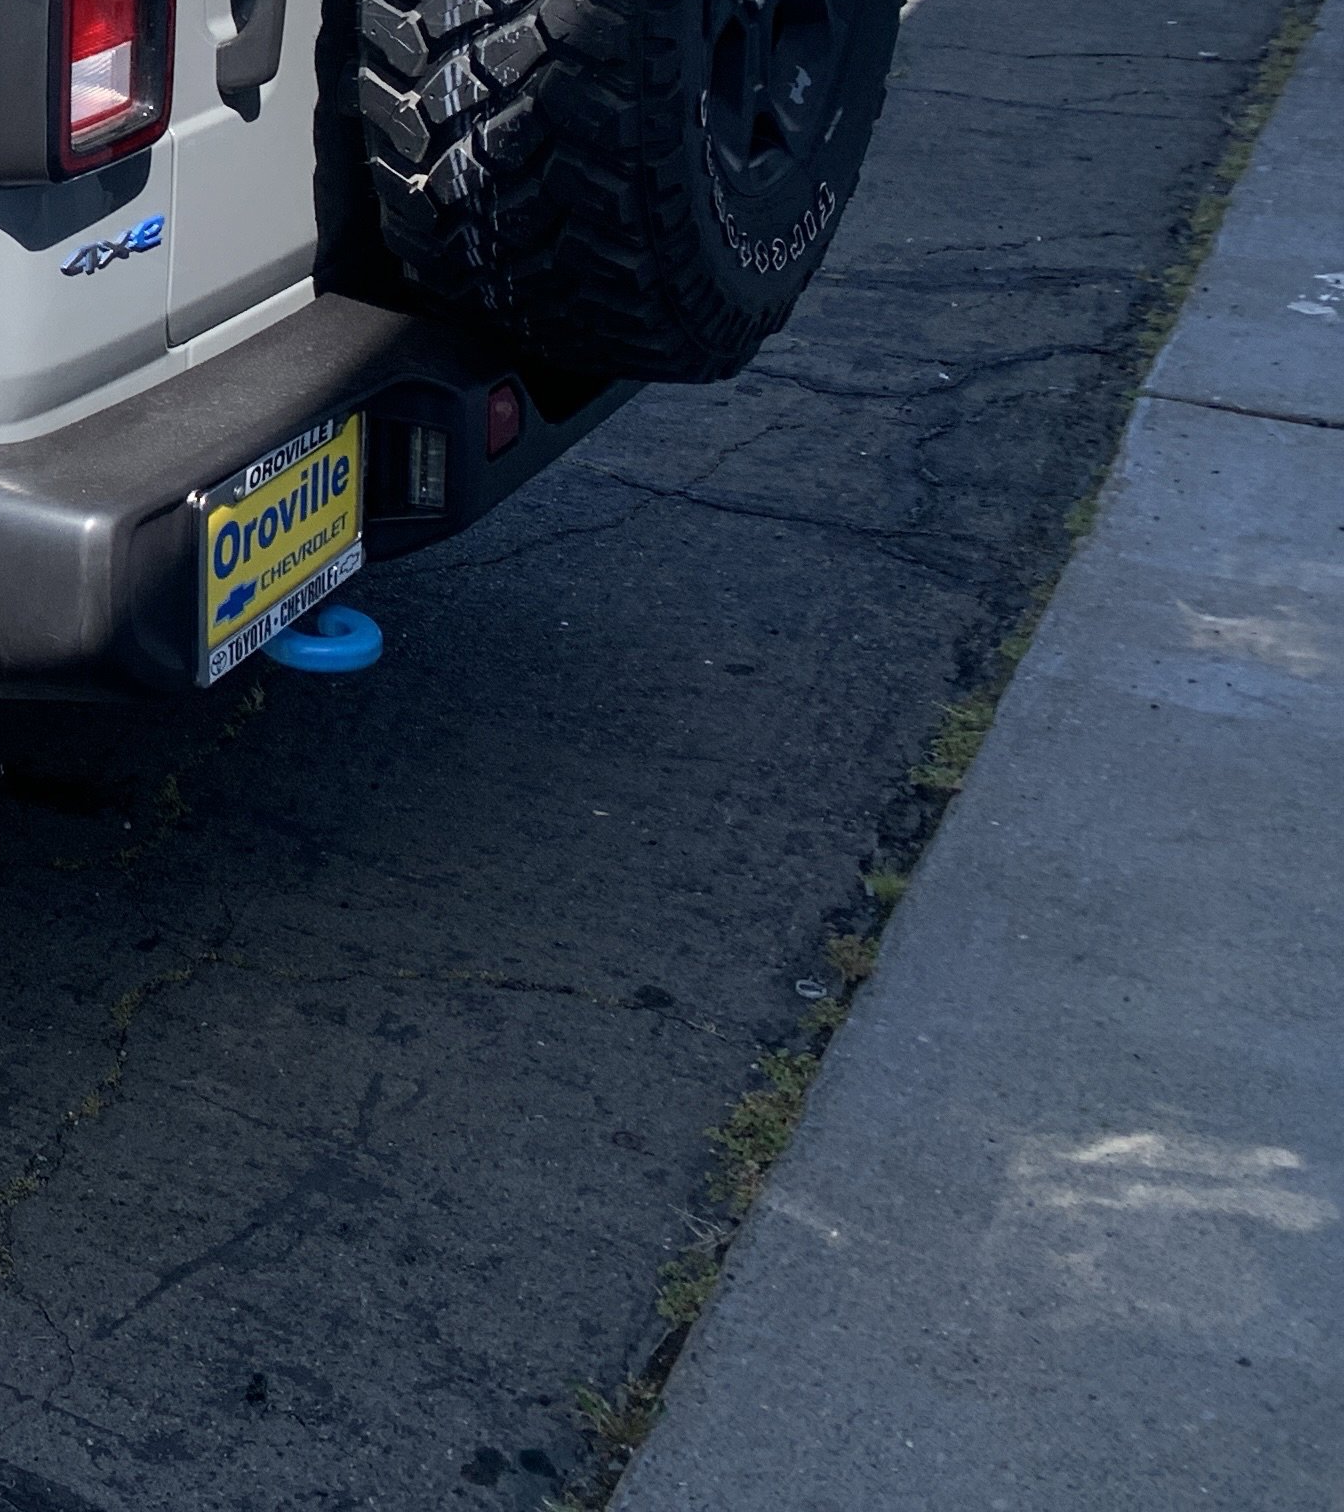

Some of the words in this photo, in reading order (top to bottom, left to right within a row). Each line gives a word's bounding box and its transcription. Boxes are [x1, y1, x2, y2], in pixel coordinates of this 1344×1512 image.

[249, 420, 333, 489] OROVILLE
[213, 454, 351, 580] Oroville
[260, 511, 349, 591] CHEVROLET
[227, 614, 273, 667] TOYOTA
[279, 562, 340, 628] CHEVROLET
